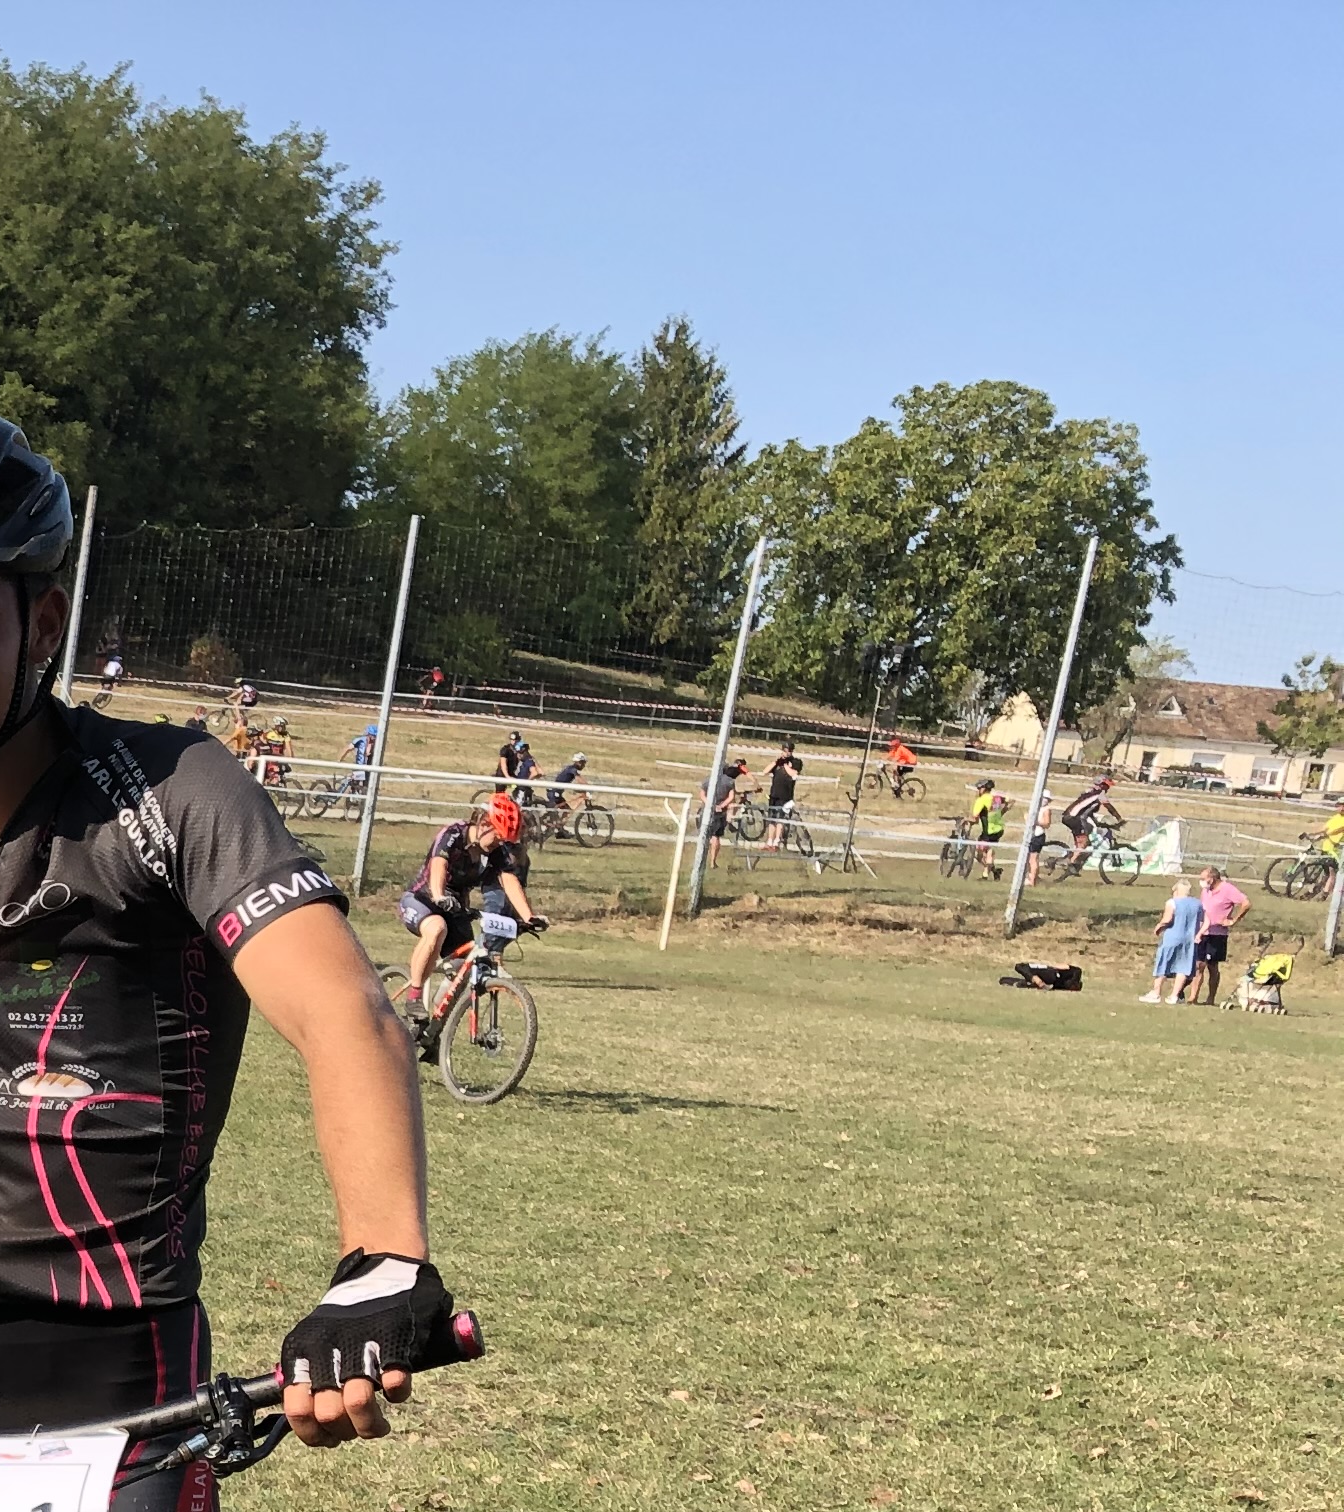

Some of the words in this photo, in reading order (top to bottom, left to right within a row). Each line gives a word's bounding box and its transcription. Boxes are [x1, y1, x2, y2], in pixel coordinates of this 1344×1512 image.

[7, 1012, 21, 1021] 02
[23, 1012, 37, 1022] 43
[70, 1013, 84, 1023] 27
